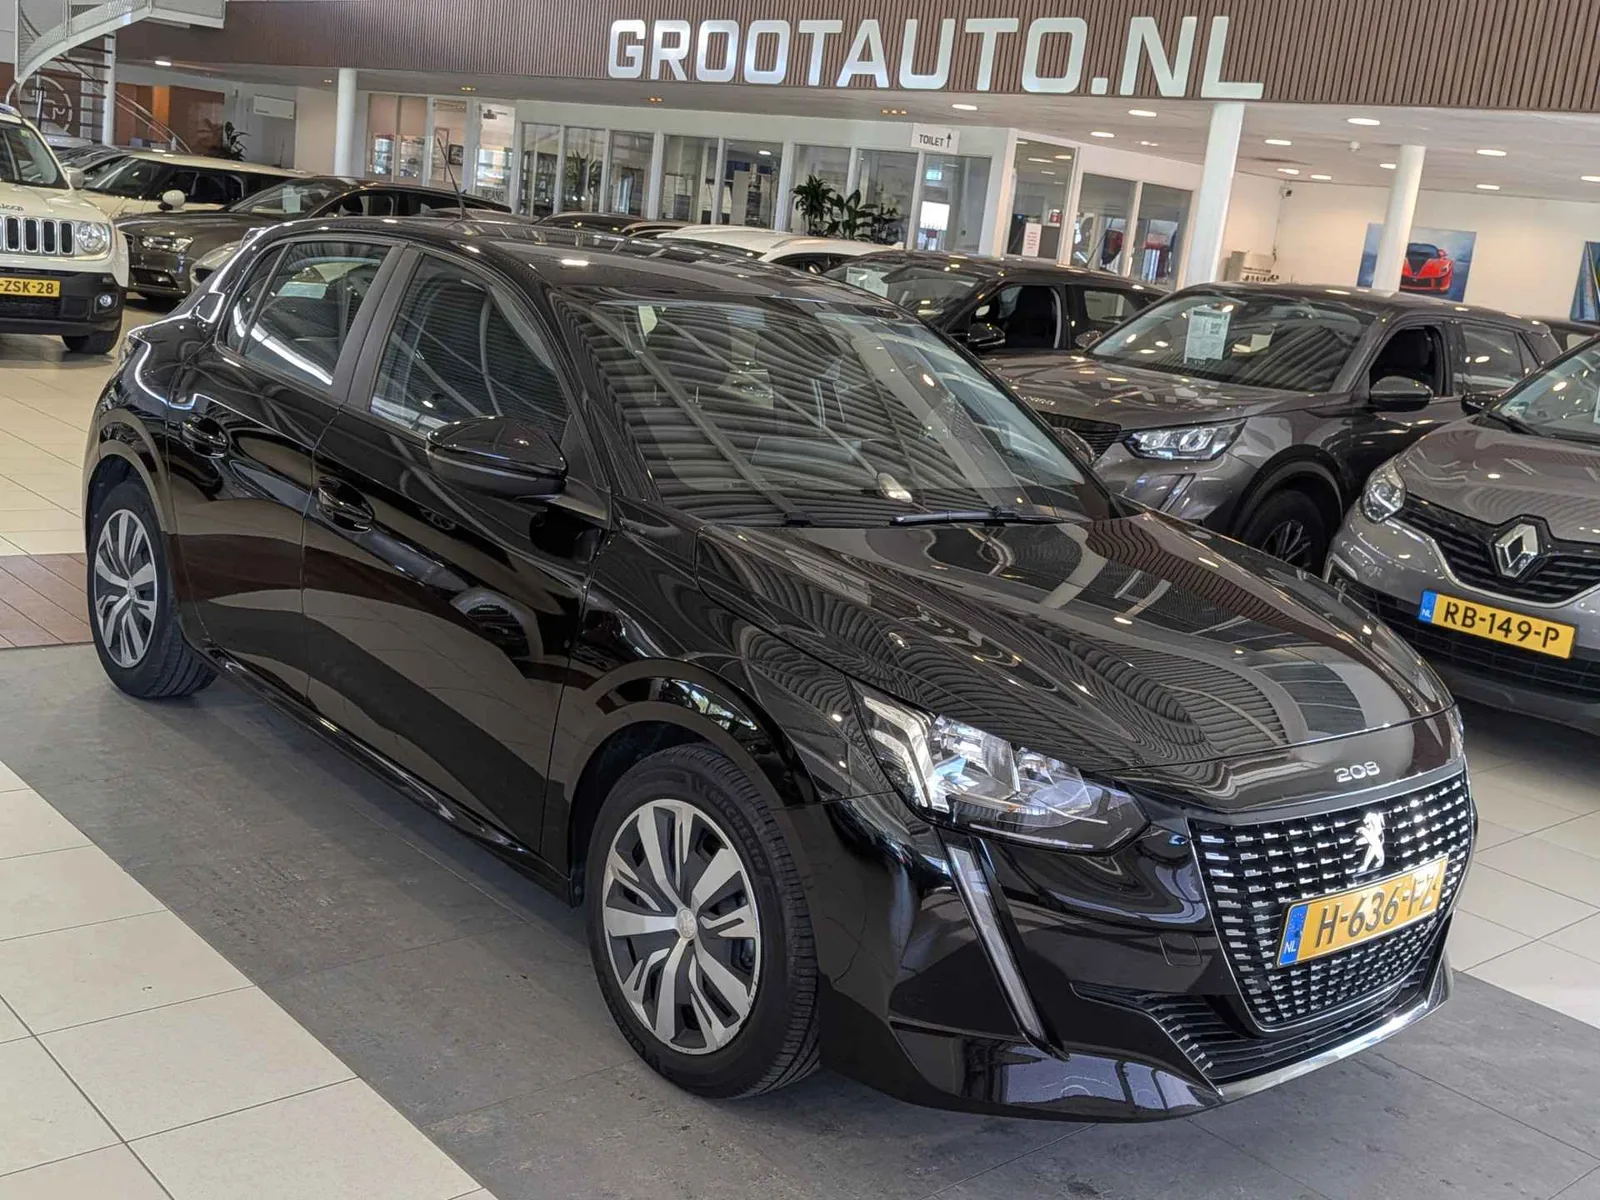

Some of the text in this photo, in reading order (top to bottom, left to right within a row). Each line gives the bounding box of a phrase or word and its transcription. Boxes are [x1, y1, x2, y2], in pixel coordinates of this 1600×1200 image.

[608, 16, 1264, 99] GROOTAUTO.NL
[919, 134, 944, 147] TOILET
[1421, 601, 1560, 648] NL RB-149-P
[1333, 761, 1380, 782] 208
[1284, 940, 1298, 953] NL
